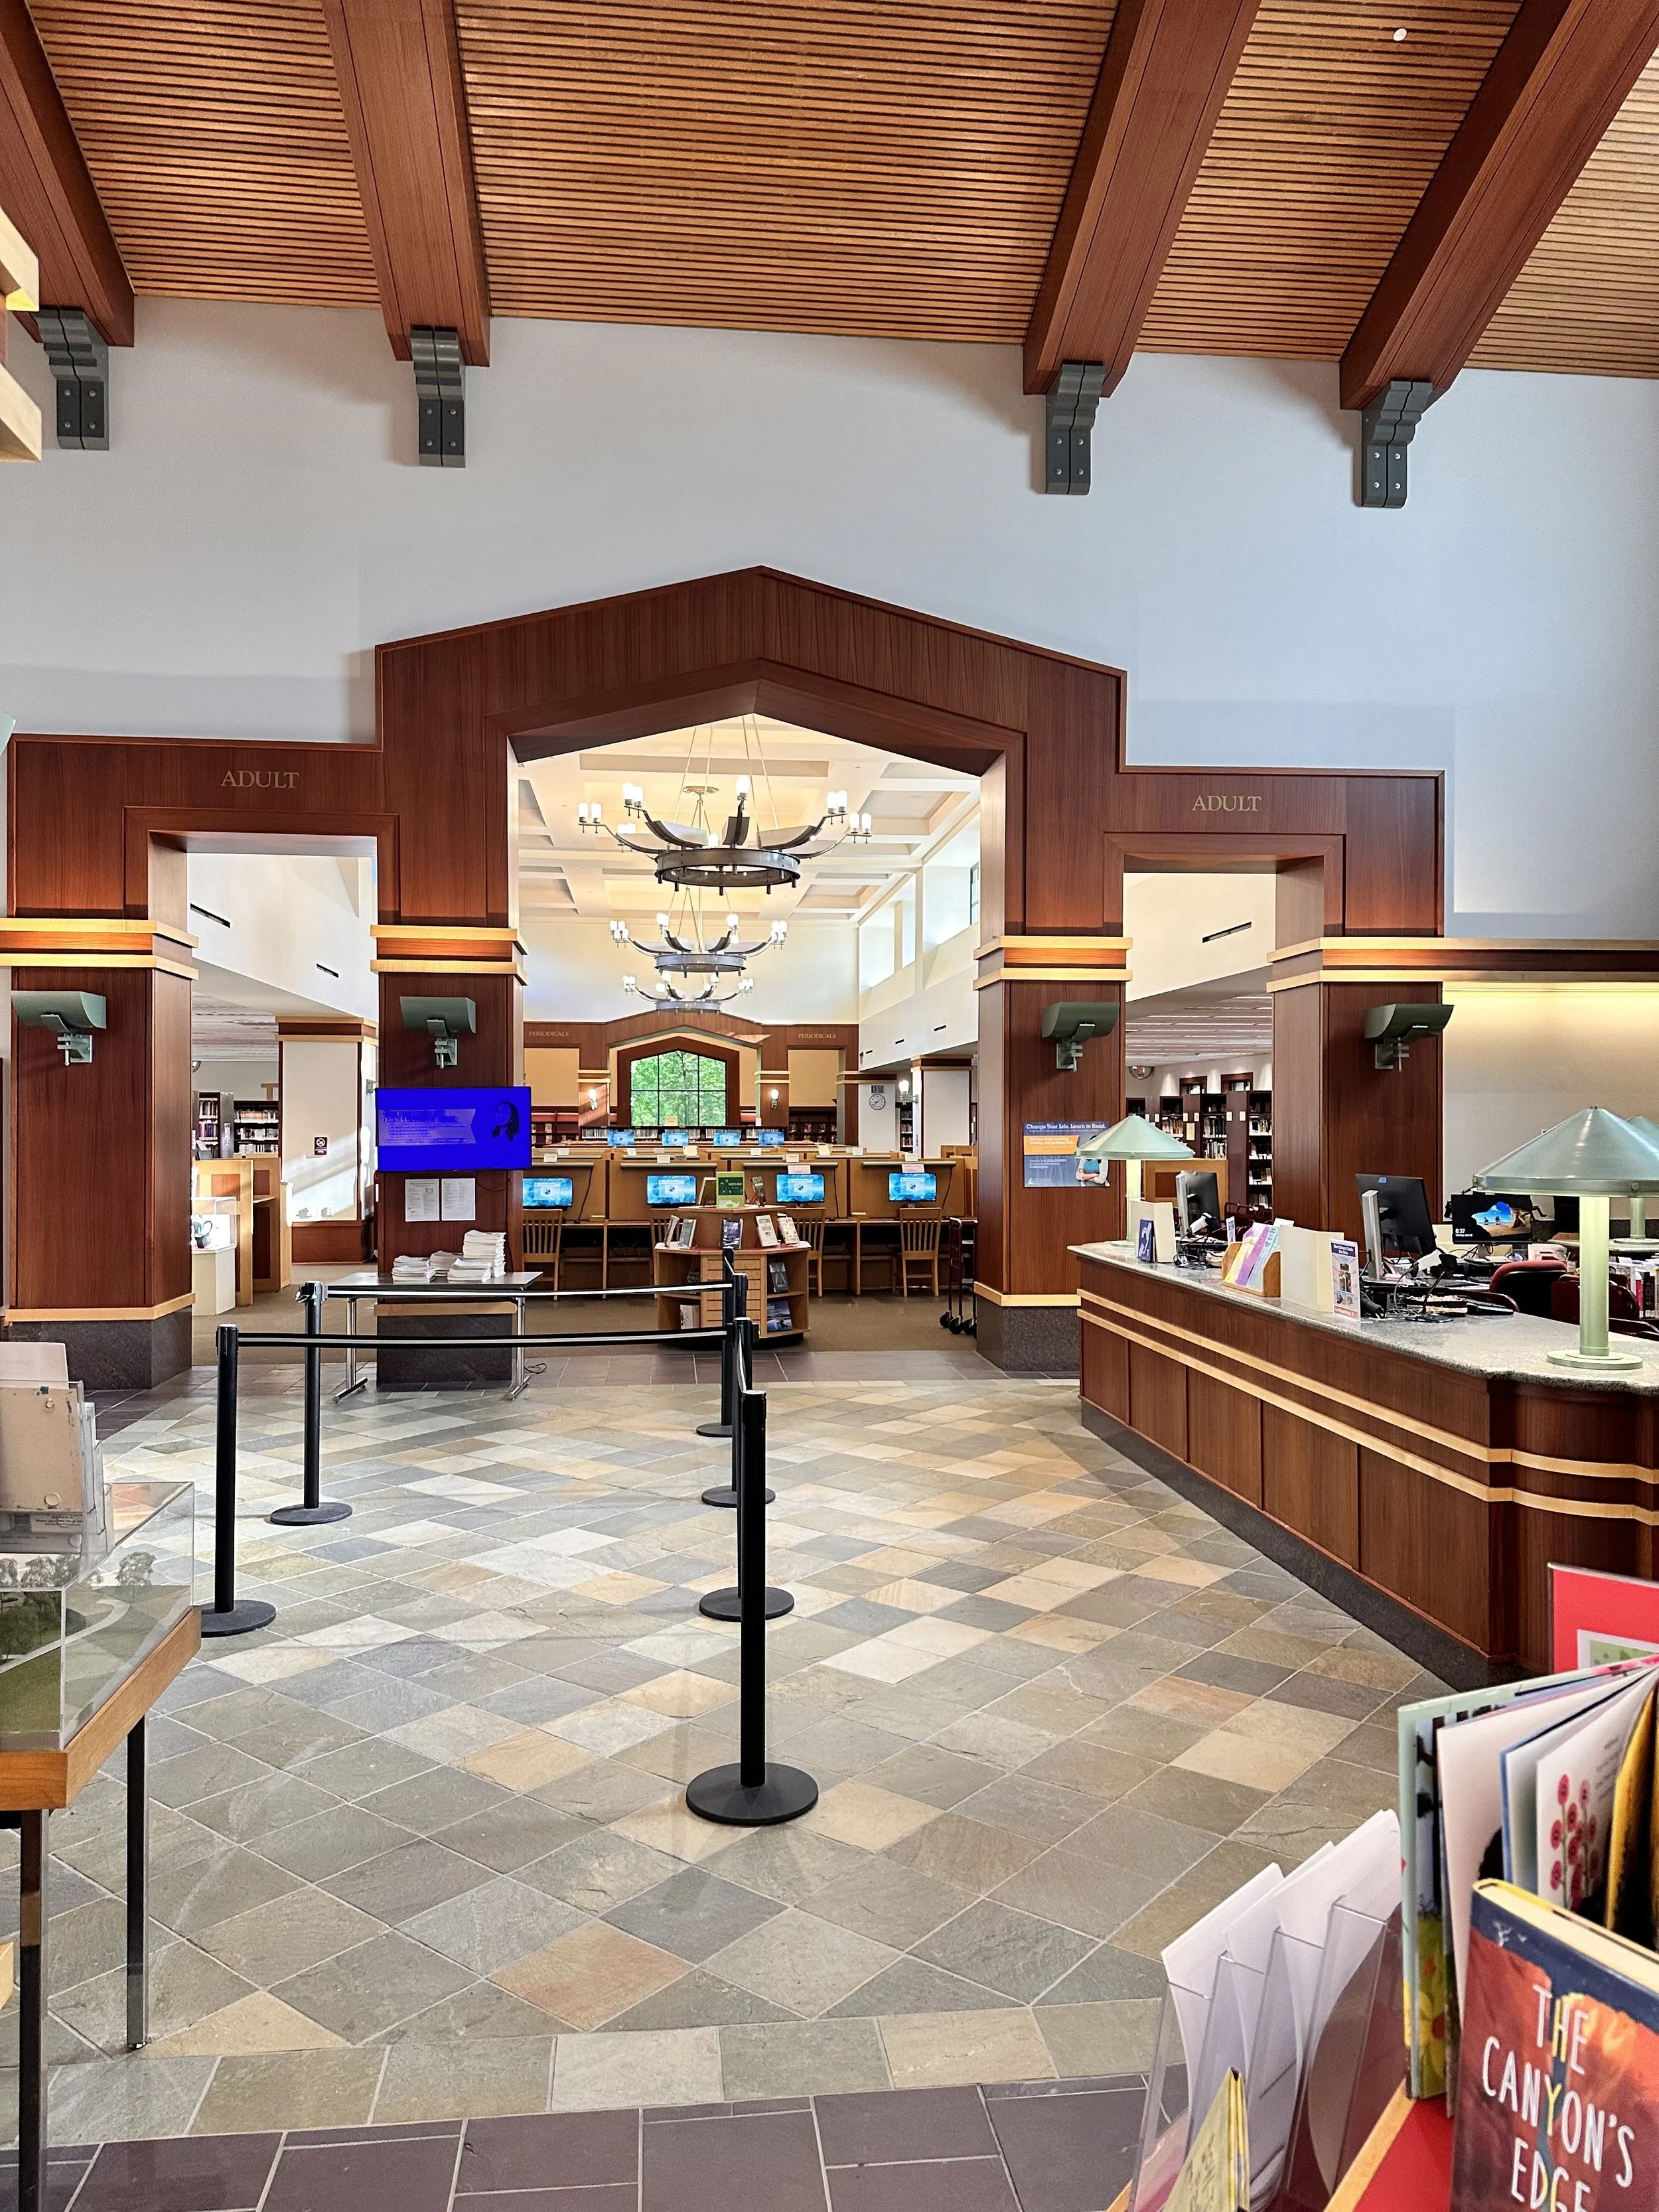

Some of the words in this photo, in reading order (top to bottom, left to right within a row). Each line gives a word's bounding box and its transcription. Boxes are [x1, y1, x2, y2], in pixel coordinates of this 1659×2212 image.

[220, 770, 299, 788] ADULT
[1192, 795, 1262, 812] ADULT
[1532, 1984, 1589, 2075] THE
[1482, 2036, 1635, 2187] CANYON'S
